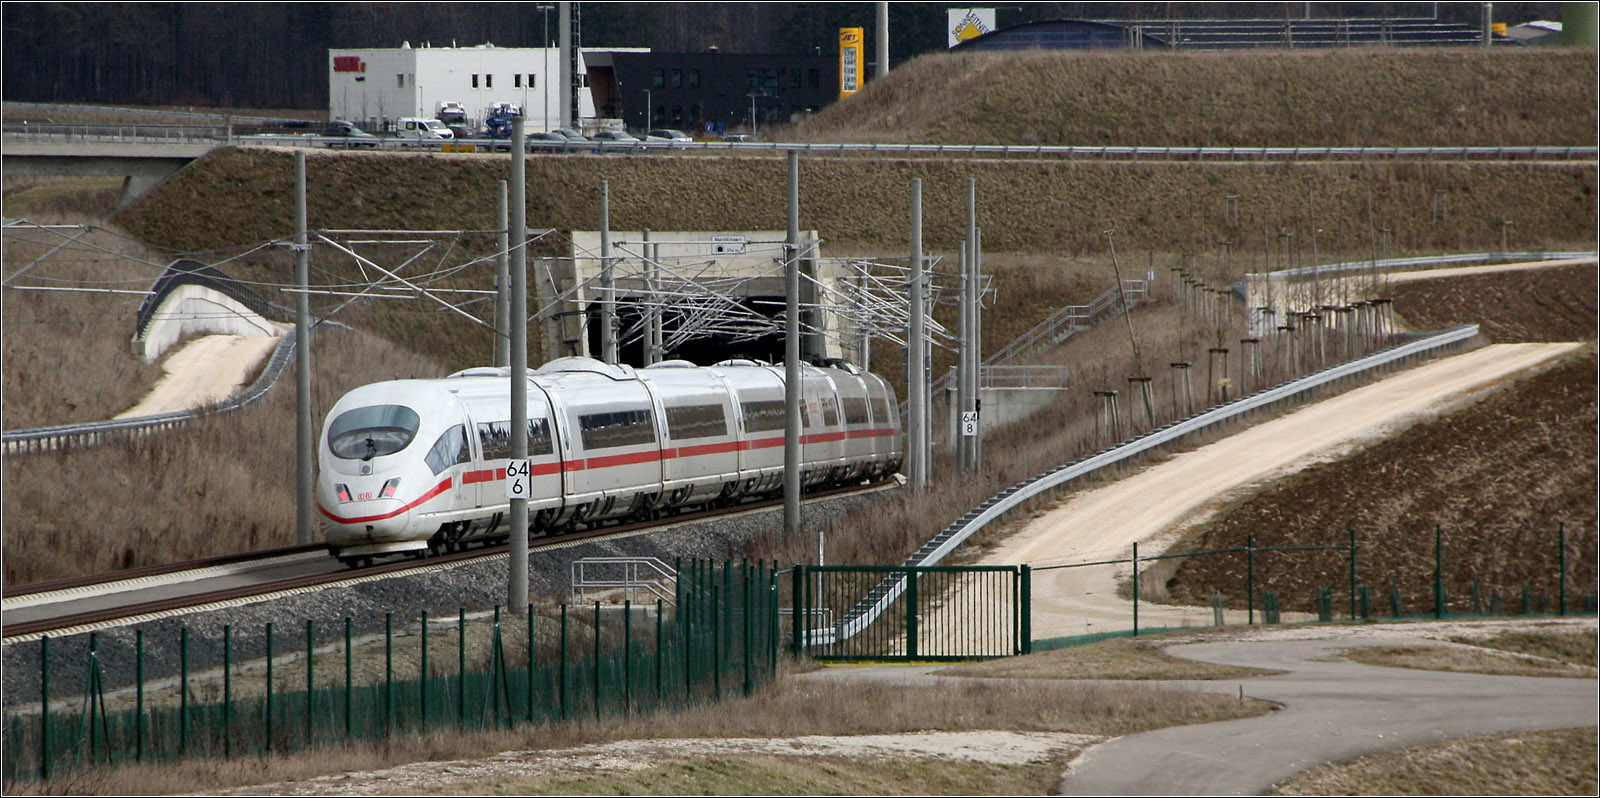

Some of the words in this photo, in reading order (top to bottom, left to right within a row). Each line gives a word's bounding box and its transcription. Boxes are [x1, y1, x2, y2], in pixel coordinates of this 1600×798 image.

[963, 413, 976, 422] 64
[967, 423, 973, 433] 8
[506, 461, 528, 477] 64
[512, 478, 523, 494] 6
